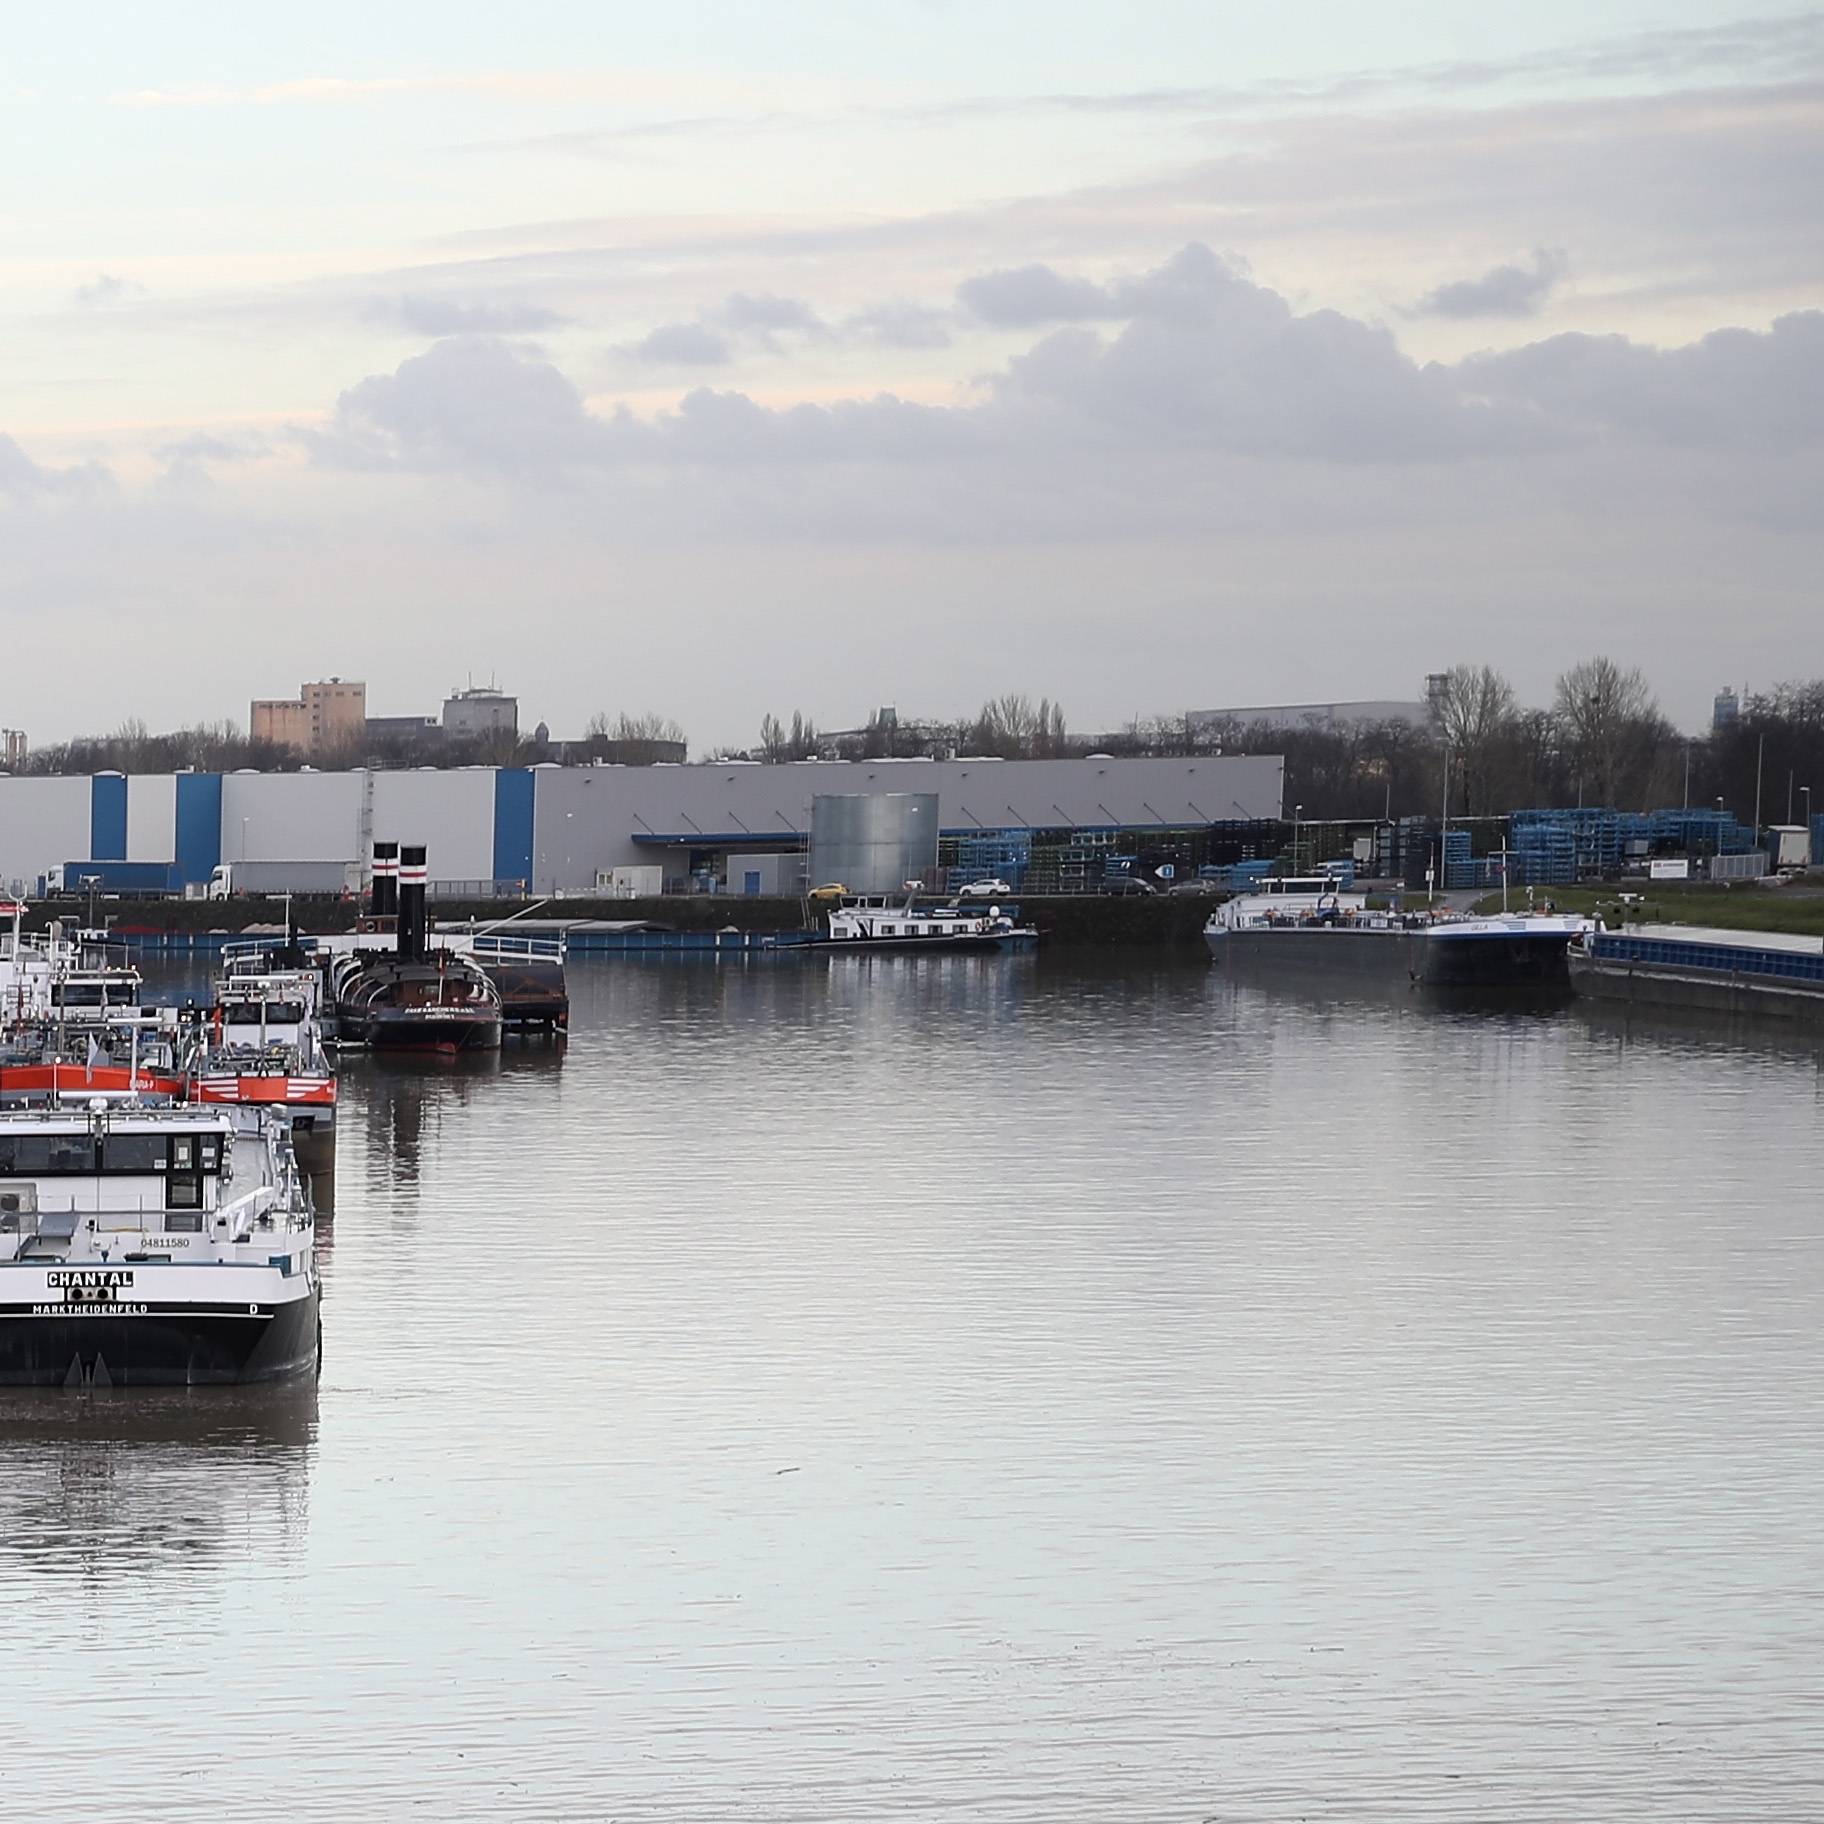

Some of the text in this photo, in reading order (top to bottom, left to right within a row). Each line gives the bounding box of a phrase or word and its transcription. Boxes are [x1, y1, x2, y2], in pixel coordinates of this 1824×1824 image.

[140, 1237, 191, 1249] 04811580
[47, 1272, 133, 1287] CHANTAL
[32, 1303, 148, 1315] MARKTHEIDENFELD
[249, 1304, 258, 1315] D
